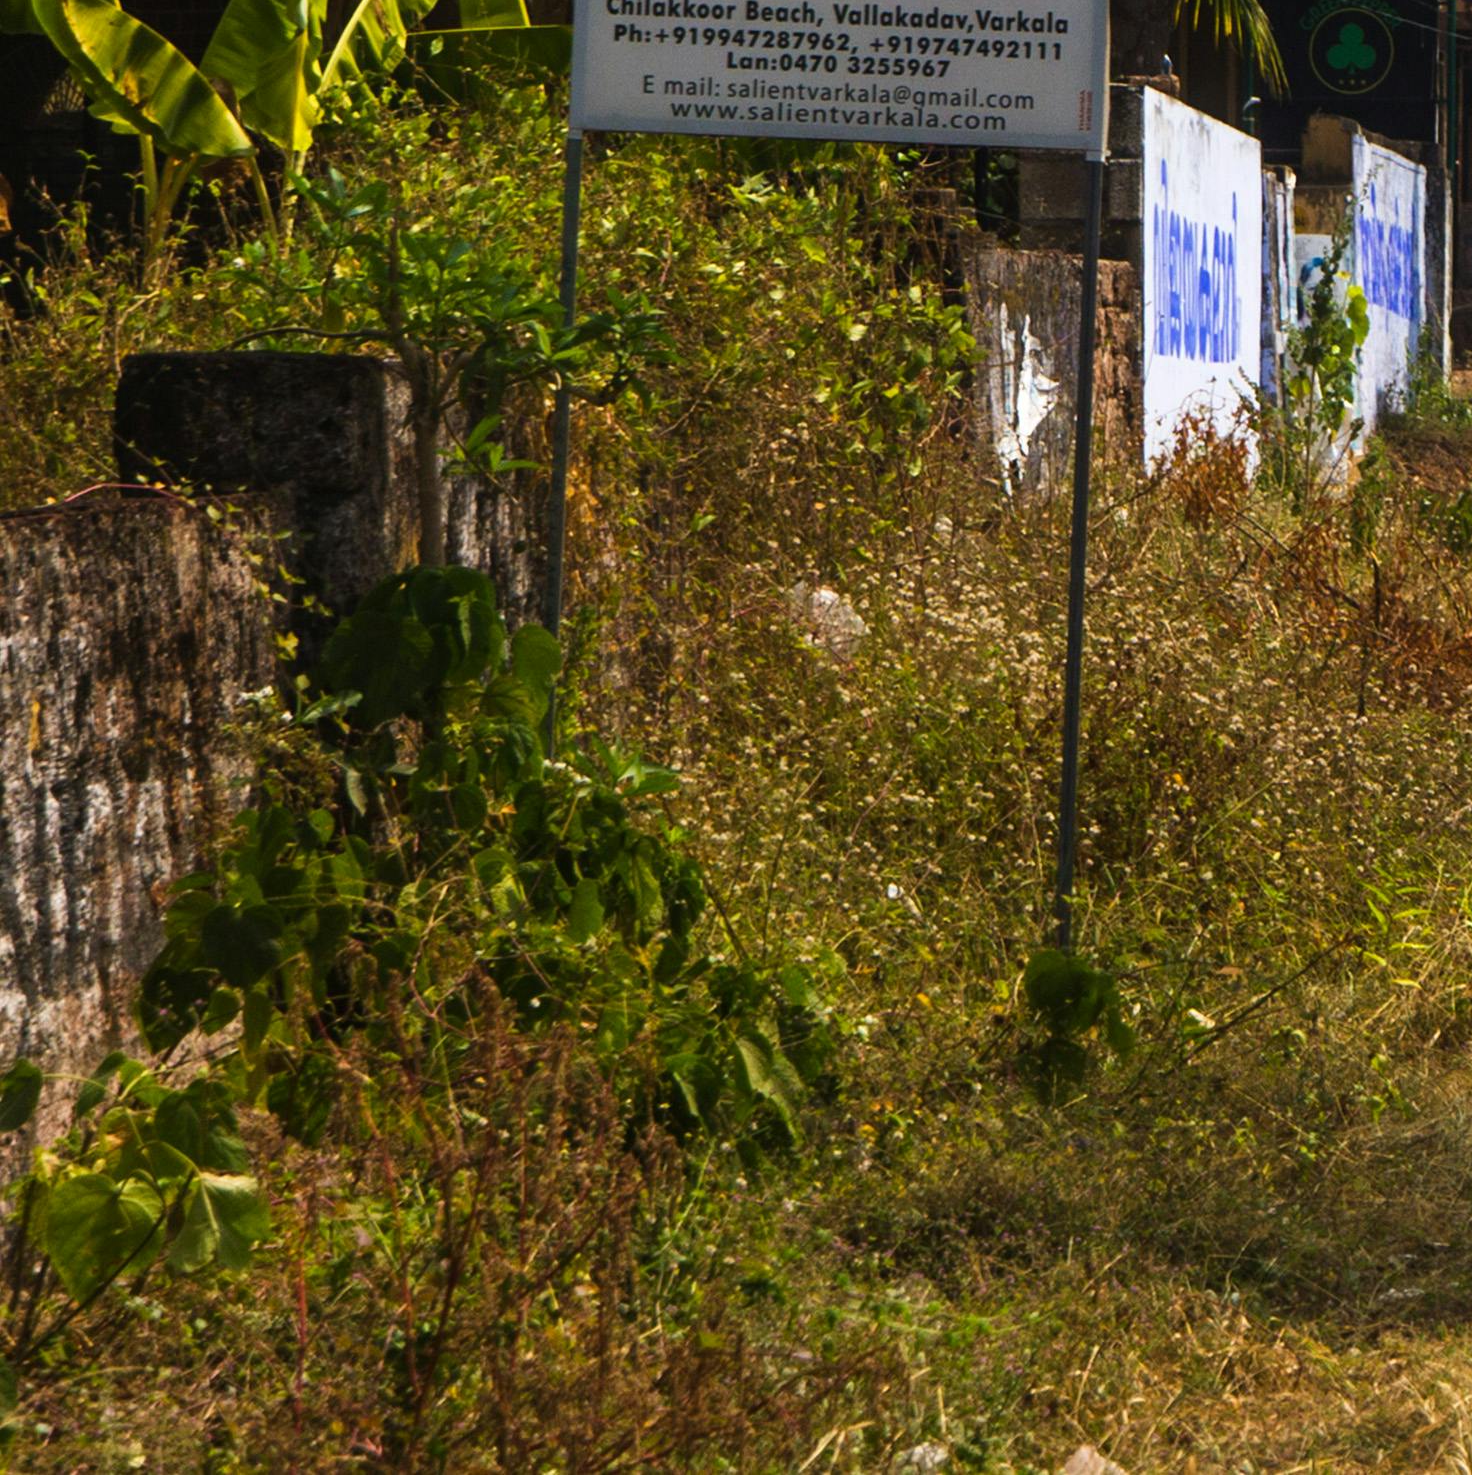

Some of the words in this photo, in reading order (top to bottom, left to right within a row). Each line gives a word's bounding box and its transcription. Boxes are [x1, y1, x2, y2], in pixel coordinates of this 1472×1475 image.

[745, 0, 824, 27] Beach,
[869, 36, 1062, 60] +919747492111
[726, 51, 838, 73] Lan:0470
[847, 57, 950, 77] 3255967
[642, 75, 655, 94] E
[663, 77, 720, 97] mail:
[727, 79, 1034, 110] salientvarkala@gmail.com
[671, 102, 1007, 131] www.salientvarkala.com
